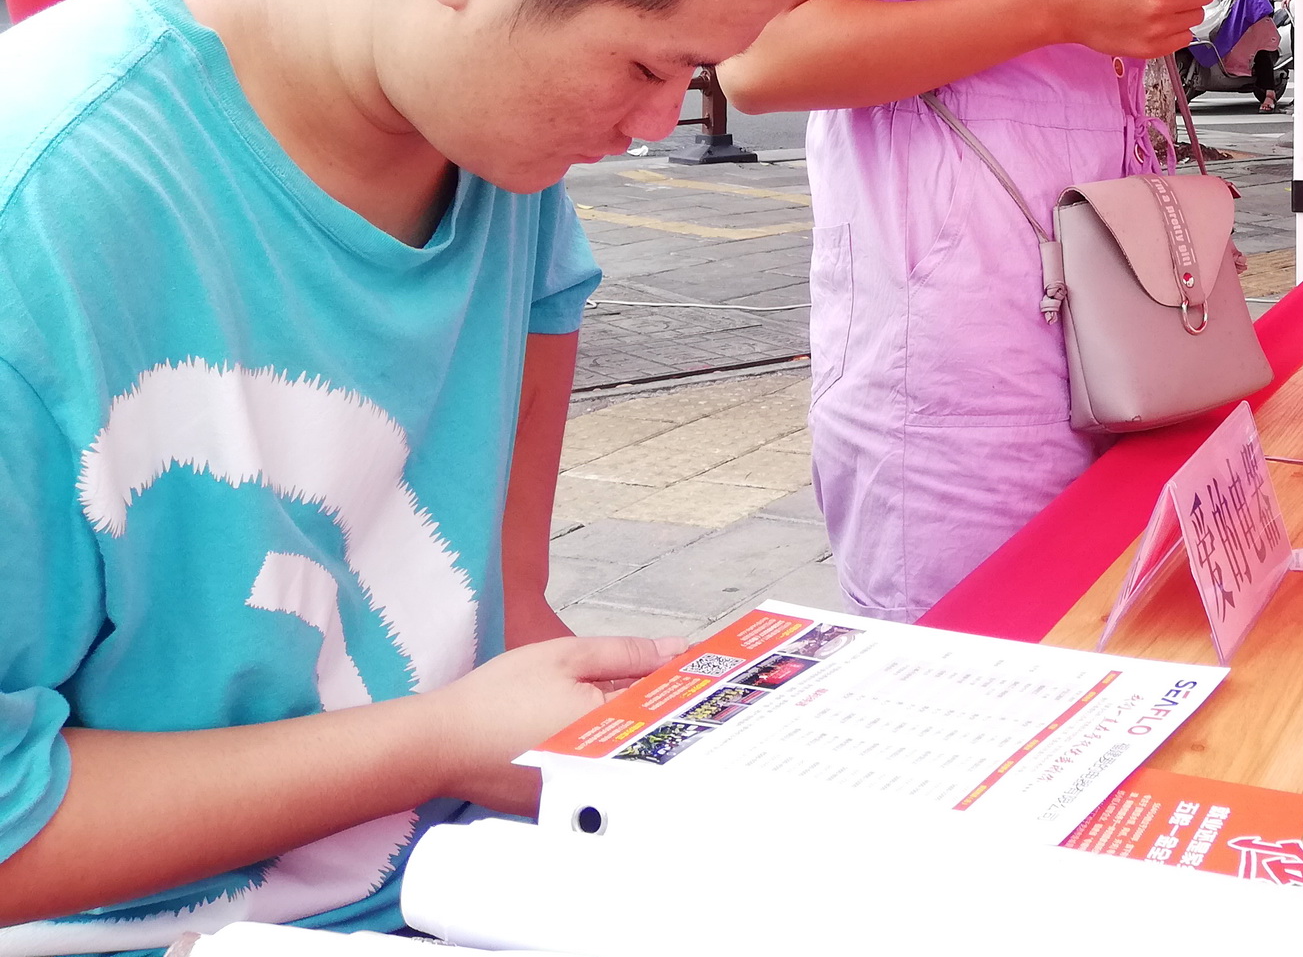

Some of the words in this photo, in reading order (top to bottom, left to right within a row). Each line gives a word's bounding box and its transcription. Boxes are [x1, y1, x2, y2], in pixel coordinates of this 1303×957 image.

[1165, 205, 1185, 241] pretty
[1178, 244, 1192, 266] girl
[1190, 442, 1281, 624] 爱的电器
[1127, 679, 1198, 736] SEAFLO
